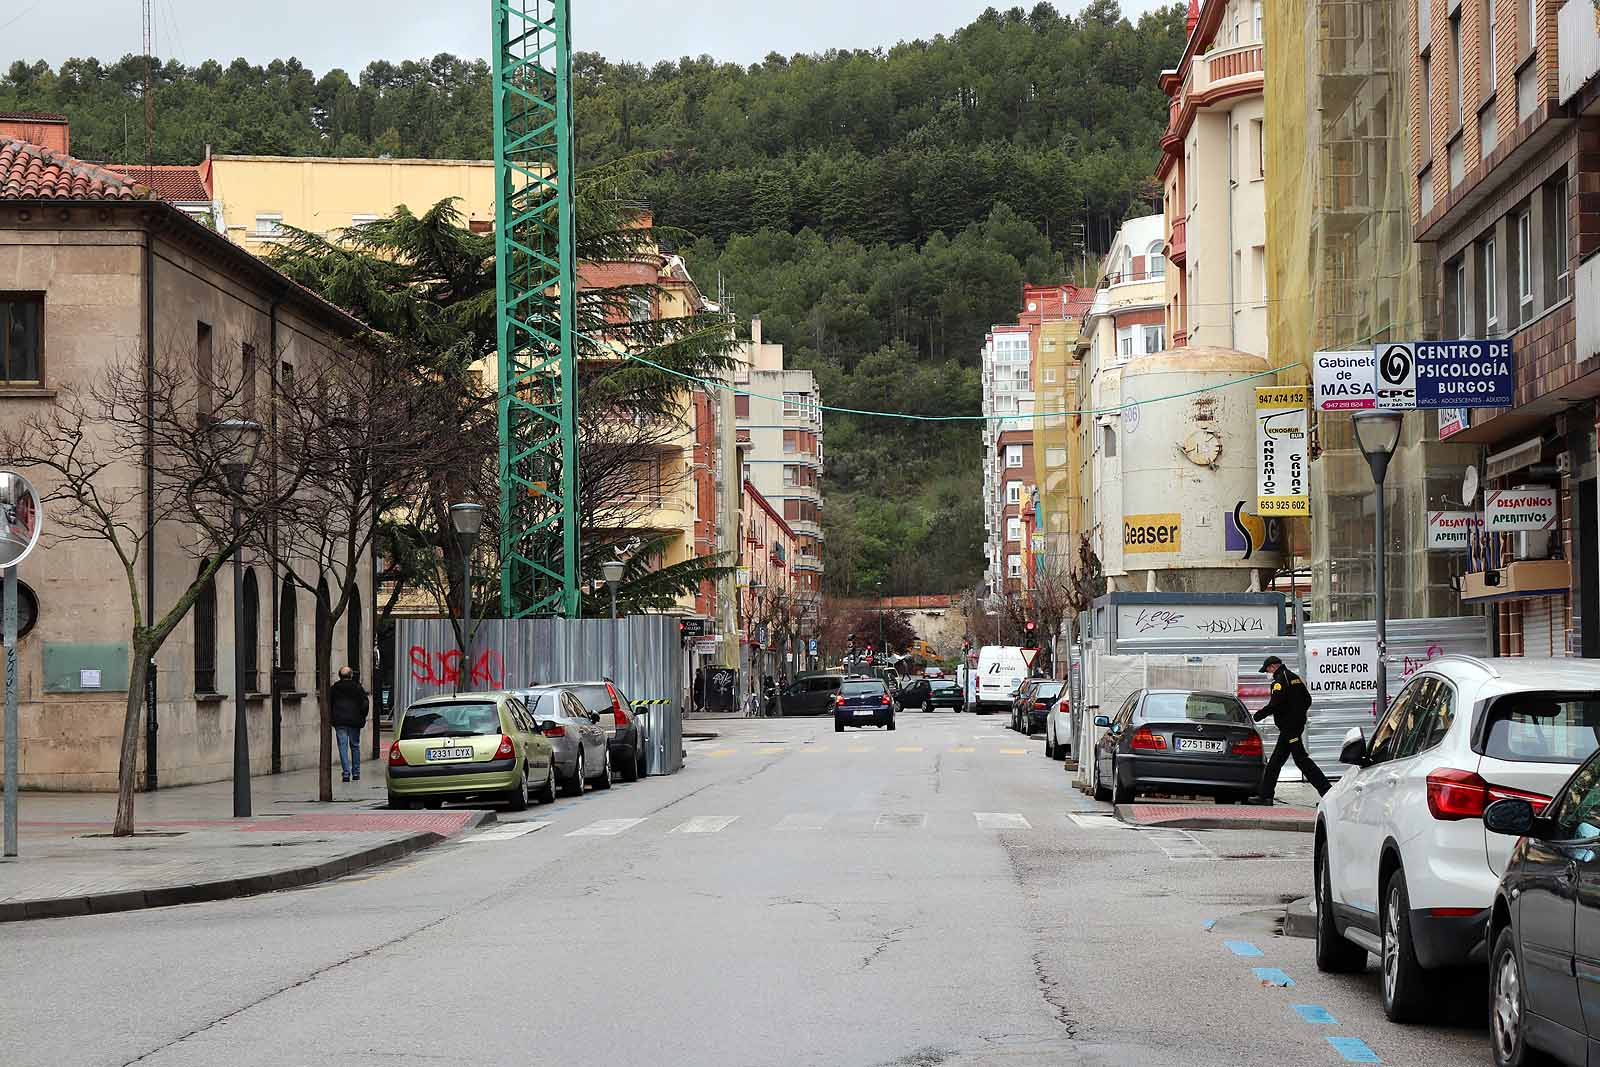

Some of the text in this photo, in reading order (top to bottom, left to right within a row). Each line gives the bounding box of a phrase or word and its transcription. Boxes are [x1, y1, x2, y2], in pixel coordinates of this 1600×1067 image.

[1417, 344, 1509, 359] CENTRO DE
[1318, 356, 1375, 369] Gabinete
[1417, 359, 1509, 378] PSICOLOGÍA
[1336, 370, 1352, 380] de
[1377, 389, 1415, 398] CPC
[1438, 381, 1496, 394] BURGOS
[1259, 393, 1304, 404] 947 474 132
[1263, 440, 1276, 495] ANDAMIOS
[1290, 454, 1301, 495] GRUAS
[1261, 501, 1305, 510] 653 925 602
[1497, 496, 1553, 509] DESAYUNOS
[1492, 512, 1547, 525] APERITIVOS
[1124, 521, 1179, 545] Geaser
[1435, 532, 1467, 542] APERITI
[1326, 646, 1360, 657] PEATON
[1319, 662, 1369, 674] CRUCE POR
[1311, 681, 1321, 692] LA
[1322, 681, 1347, 691] OTRA
[1349, 680, 1378, 691] ACERA
[1181, 739, 1222, 750] 2751 BWZ
[431, 747, 470, 759] 2331 CYX
